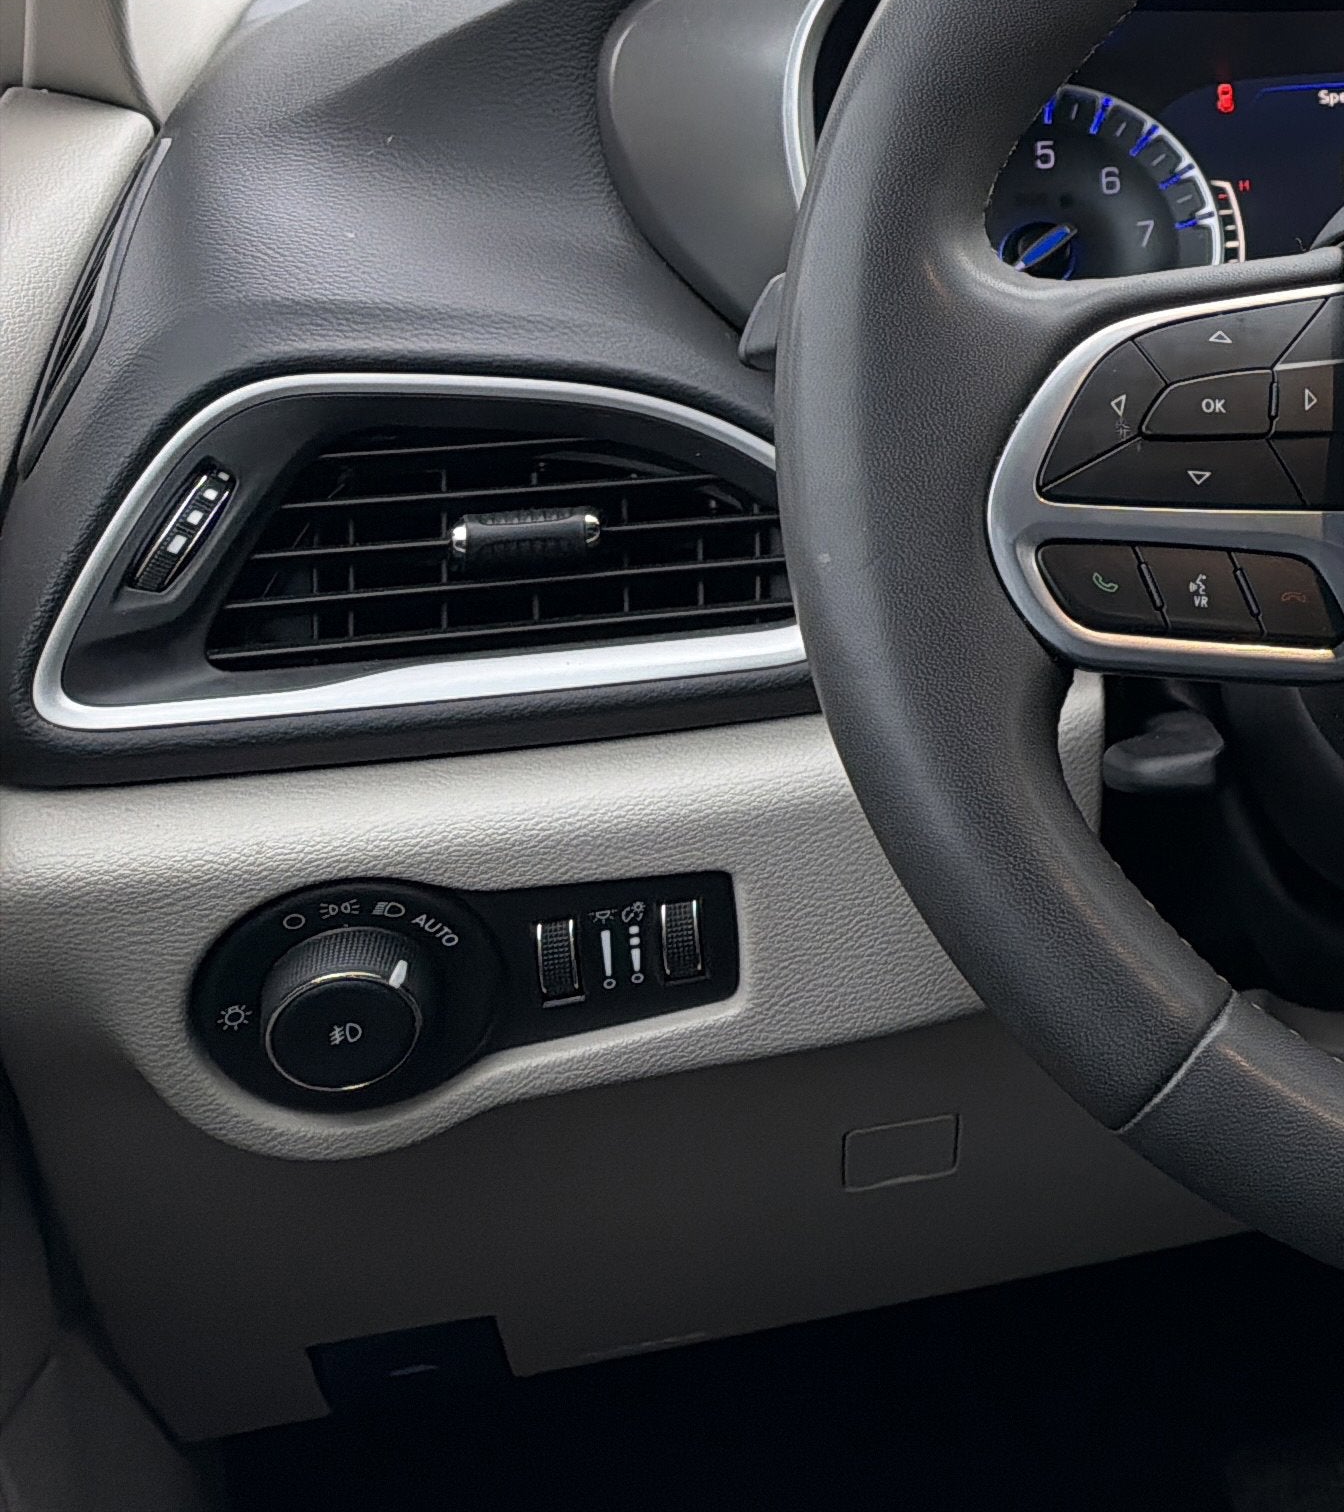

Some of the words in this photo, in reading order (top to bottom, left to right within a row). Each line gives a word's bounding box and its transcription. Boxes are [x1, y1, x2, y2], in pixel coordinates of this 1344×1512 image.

[1034, 140, 1056, 170] 5
[1100, 166, 1121, 196] 6
[1136, 219, 1155, 249] 7
[1201, 398, 1226, 415] OK
[1193, 595, 1209, 609] VR
[410, 912, 460, 949] AUTO
